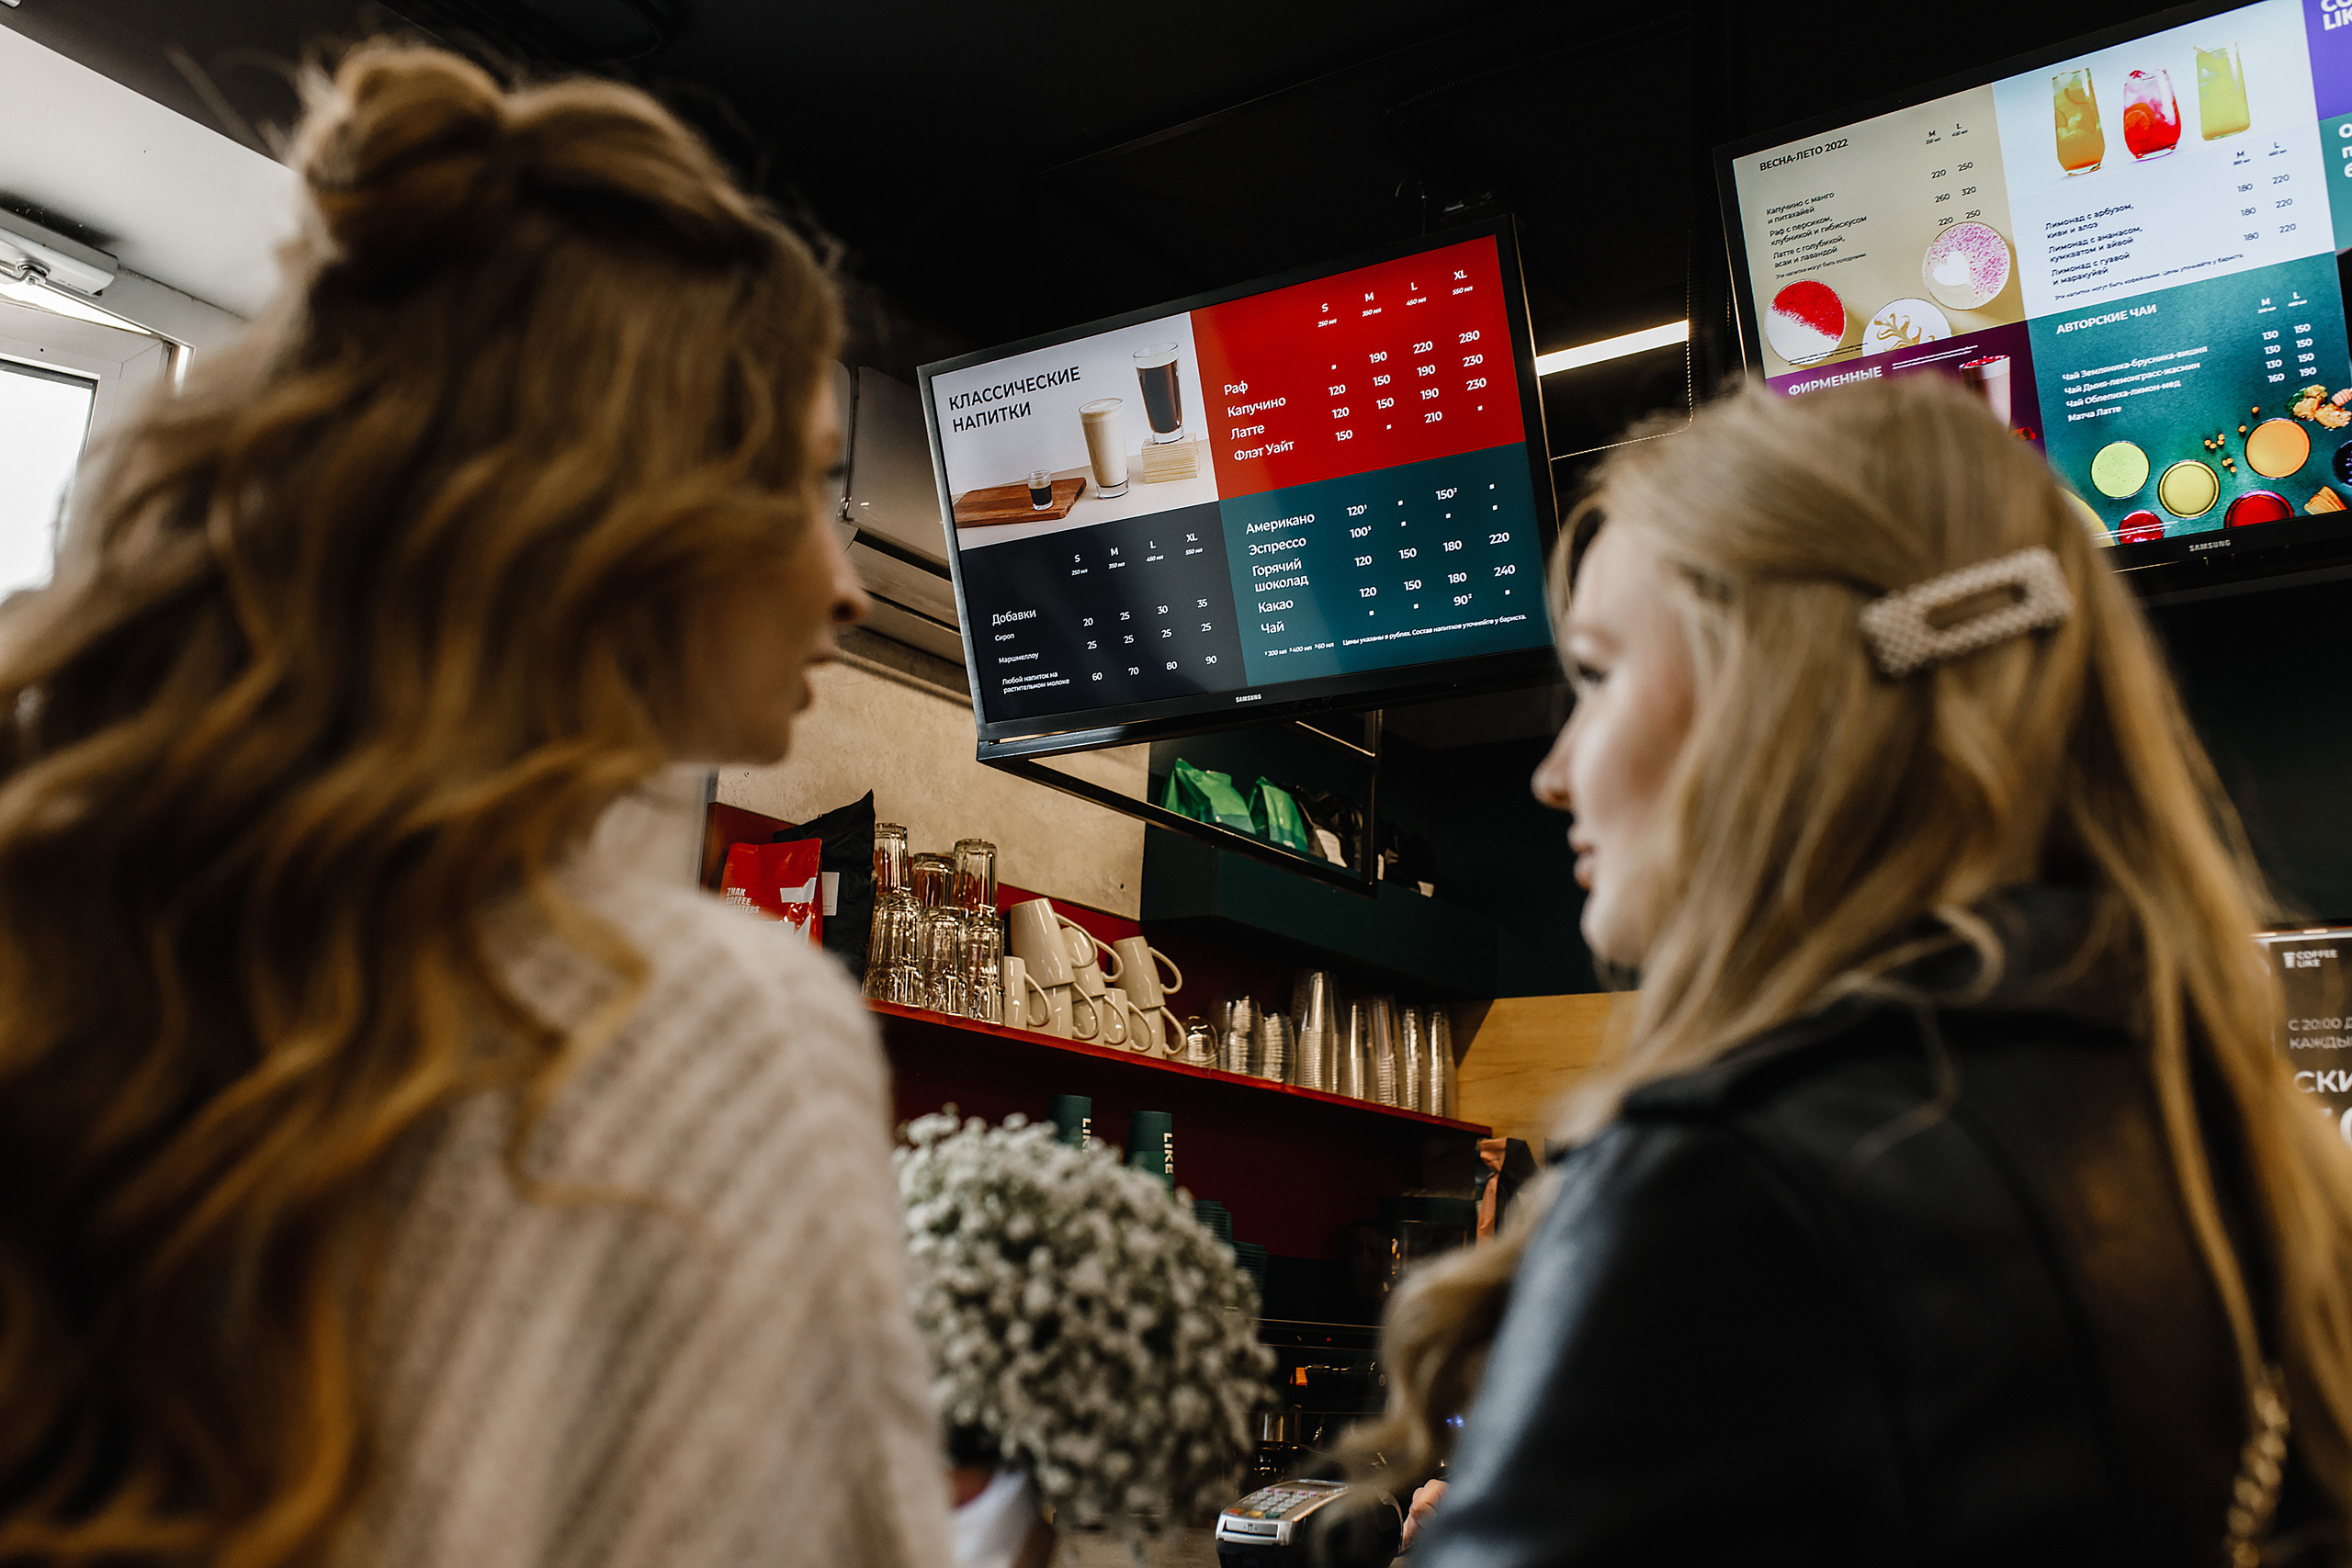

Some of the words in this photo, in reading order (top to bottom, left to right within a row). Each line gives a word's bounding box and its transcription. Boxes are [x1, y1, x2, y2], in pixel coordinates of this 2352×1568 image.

[1760, 146, 1823, 171] ВЕСНА-ЛЕТО
[1825, 139, 1849, 152] 2022
[1766, 200, 1804, 215] Капучино
[1811, 192, 1835, 202] манго
[1931, 169, 1946, 179] 220
[1958, 162, 1973, 172] 250
[2045, 216, 2085, 230] Лимонад
[2095, 204, 2133, 218] арбузом,
[2237, 184, 2253, 193] 180
[2272, 175, 2290, 184] 220
[1770, 229, 1785, 237] Раф
[1792, 216, 1832, 231] персиком,
[1935, 193, 1950, 203] 260
[1962, 186, 1976, 196] 320
[1771, 230, 1813, 246] клубникой
[1821, 216, 1867, 233] гибискусом
[1774, 206, 1815, 223] питахайей
[2047, 230, 2068, 239] киви
[2078, 222, 2098, 231] алоэ
[2049, 240, 2088, 254] Лимонад
[2098, 227, 2143, 242] ананасом,
[2241, 208, 2256, 217] 180
[2276, 198, 2293, 209] 220
[1773, 249, 1794, 259] Латте
[1803, 235, 1845, 250] голубикой,
[1939, 217, 1953, 226] 220
[1965, 209, 1981, 219] 250
[2050, 247, 2096, 263] кумкватом
[2107, 237, 2133, 249] айвой
[2052, 263, 2091, 276] Лимонад
[2100, 252, 2130, 265] гуавой
[2244, 232, 2259, 241] 180
[2279, 223, 2296, 233] 220
[1774, 259, 1792, 268] асаи
[1801, 246, 1838, 261] лавандой
[2061, 267, 2109, 283] маракуйей
[1321, 303, 1329, 312] S
[1365, 292, 1374, 302] M
[1411, 282, 1418, 290] L
[1453, 270, 1467, 280] XL
[2056, 310, 2129, 334] АВТОРСКИЕ
[2130, 304, 2157, 318] ЧАИ
[1224, 380, 1248, 395] Раф
[1369, 351, 1387, 364] 190
[1413, 341, 1433, 354] 220
[1459, 331, 1480, 344] 280
[2063, 372, 2080, 381] Чай
[2262, 331, 2278, 340] 130
[2294, 323, 2311, 333] 150
[2064, 386, 2082, 394] Чай
[2264, 344, 2280, 355] 130
[2296, 338, 2312, 348] 150
[949, 367, 1080, 411] КЛАССИЧЕСКИЕ
[1227, 398, 1286, 417] Капучино
[1329, 384, 1346, 396] 120
[1373, 375, 1390, 386] 150
[1417, 365, 1435, 377] 190
[1463, 355, 1483, 367] 230
[1789, 366, 1883, 396] ФИРМЕННЫЕ
[2066, 399, 2084, 408] Чай
[2266, 359, 2282, 369] 130
[2298, 353, 2314, 363] 150
[2068, 411, 2095, 422] Матча
[2096, 406, 2121, 416] Латте
[2267, 373, 2285, 383] 160
[2299, 367, 2317, 377] 190
[953, 401, 1031, 433] НАПИТКИ
[1231, 425, 1264, 440] Латте
[1332, 407, 1350, 419] 120
[1376, 398, 1394, 410] 150
[1420, 388, 1439, 400] 190
[1466, 378, 1487, 390] 230
[1234, 447, 1263, 461] Флэт
[1265, 440, 1294, 455] Уайт
[1335, 430, 1352, 441] 150
[1424, 412, 1442, 423] 210
[1246, 513, 1315, 535] Американо
[1111, 547, 1119, 556] M
[1186, 533, 1198, 542] XL
[1249, 537, 1306, 555] Эспрессо
[1252, 558, 1302, 577] Горячий
[1354, 556, 1372, 567] 120
[1399, 547, 1417, 559] 150
[1443, 540, 1463, 552] 180
[1489, 532, 1510, 545] 220
[2189, 540, 2231, 551] SAMSUNG
[1255, 575, 1309, 592] шоколад
[1258, 600, 1294, 614] Какао
[1360, 587, 1376, 598] 120
[1404, 580, 1422, 591] 150
[1448, 572, 1467, 583] 180
[1494, 565, 1516, 577] 240
[992, 610, 1036, 626] Добавки
[995, 633, 1014, 641] Сироп
[1083, 617, 1093, 626] 20
[1120, 612, 1130, 620] 25
[1157, 605, 1168, 615] 30
[1197, 599, 1207, 608] 35
[1261, 621, 1284, 634] Чай
[999, 652, 1038, 663] Маршмеллоу
[1087, 640, 1097, 649] 25
[1124, 635, 1134, 644] 25
[1161, 629, 1171, 638] 25
[1201, 623, 1212, 632] 25
[1002, 676, 1023, 685] Любой
[1024, 673, 1049, 682] напиток
[1003, 682, 1046, 694] растительном
[1092, 672, 1102, 681] 60
[1128, 667, 1139, 675] 70
[1166, 661, 1177, 670] 80
[1205, 655, 1217, 664] 90
[2296, 949, 2337, 959] COFFEE
[2297, 959, 2321, 967] LIKE
[1164, 1133, 1173, 1174] LIKE
